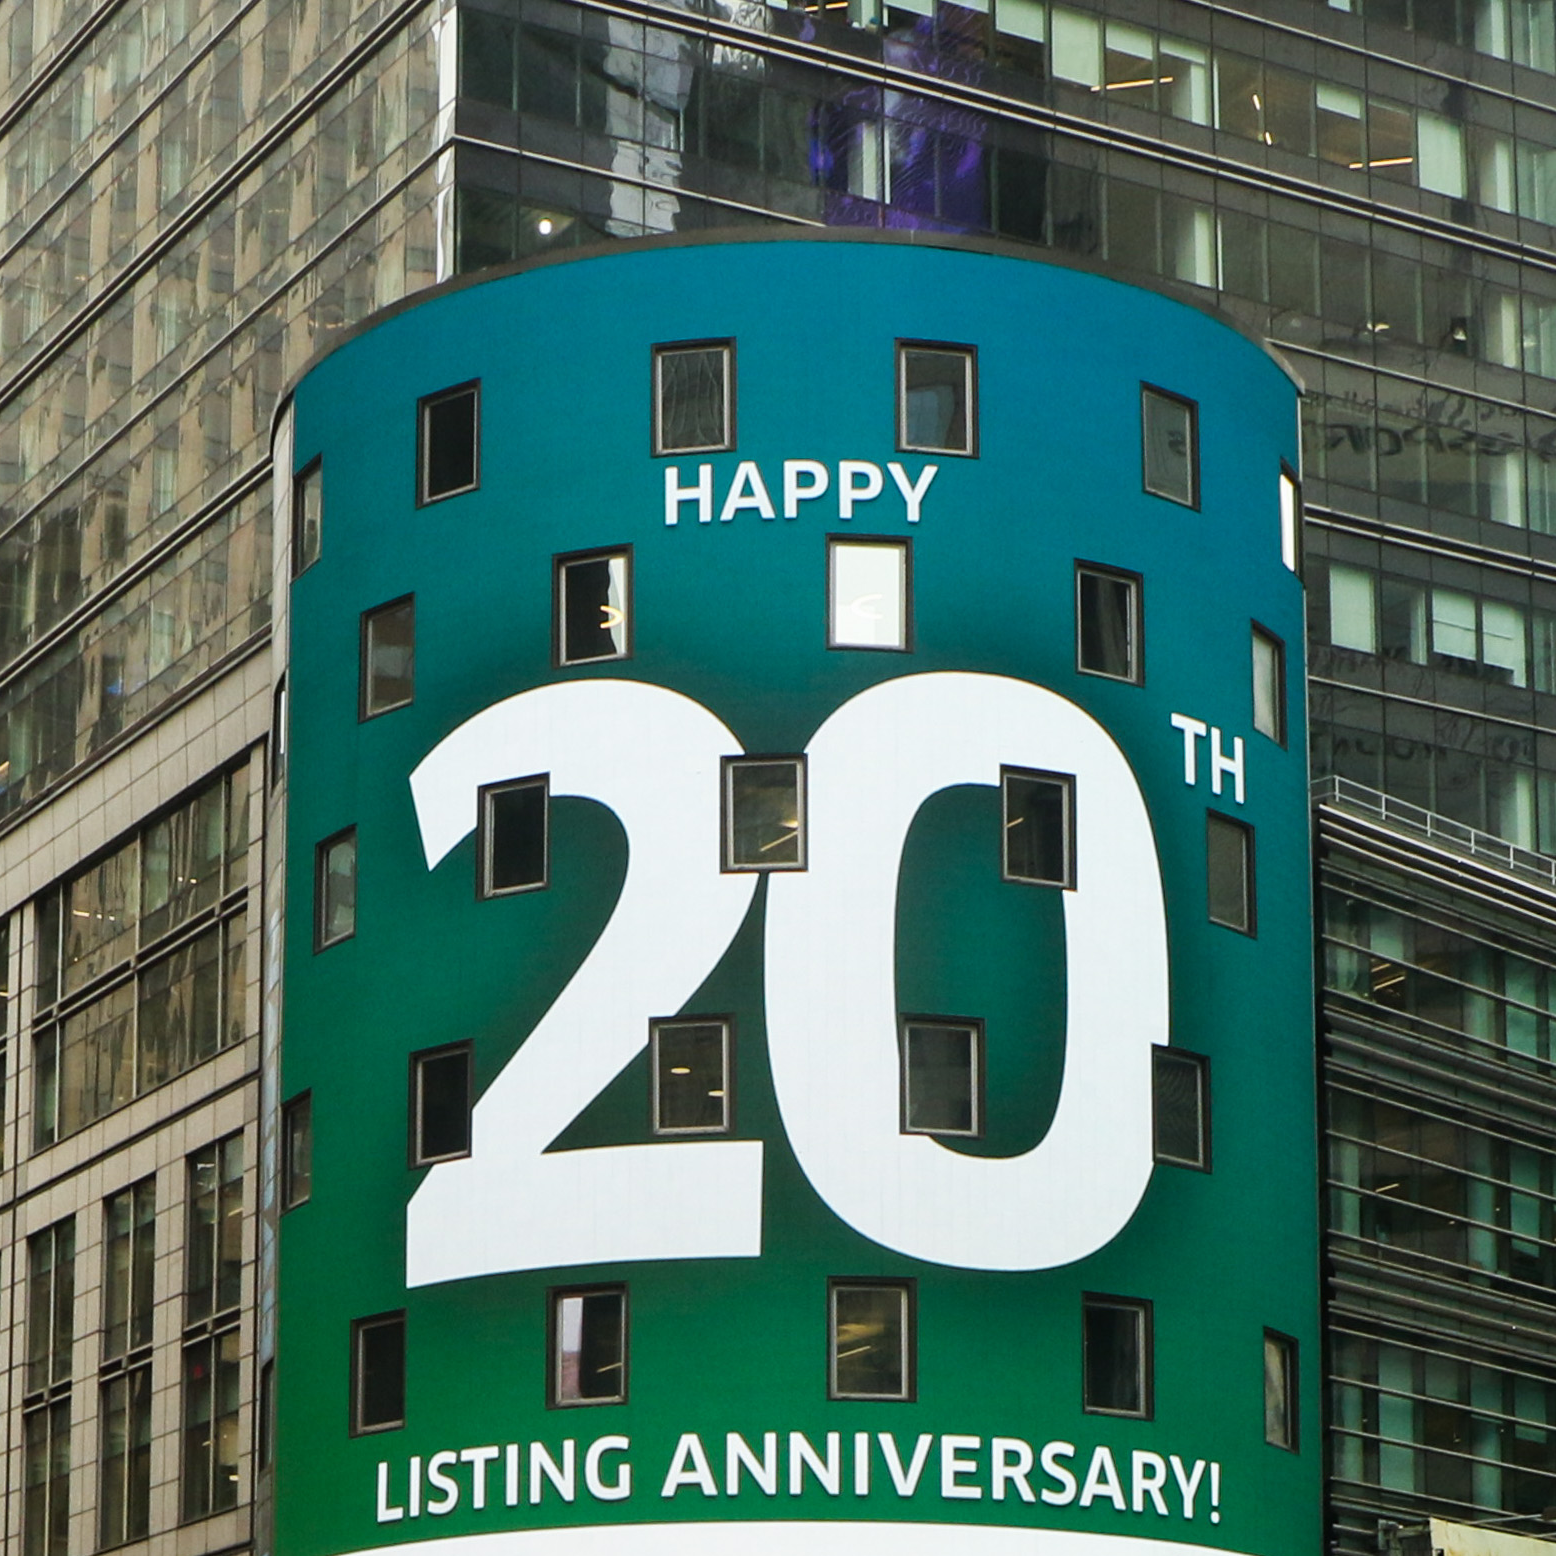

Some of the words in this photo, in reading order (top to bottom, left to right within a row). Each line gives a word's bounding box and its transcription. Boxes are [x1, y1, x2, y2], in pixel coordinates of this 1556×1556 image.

[664, 459, 938, 526] HAPPY
[406, 671, 1171, 1289] 20
[1170, 713, 1246, 803] TH
[376, 1435, 631, 1523] LISTING
[661, 1431, 1222, 1525] ANNIVERSARY!
